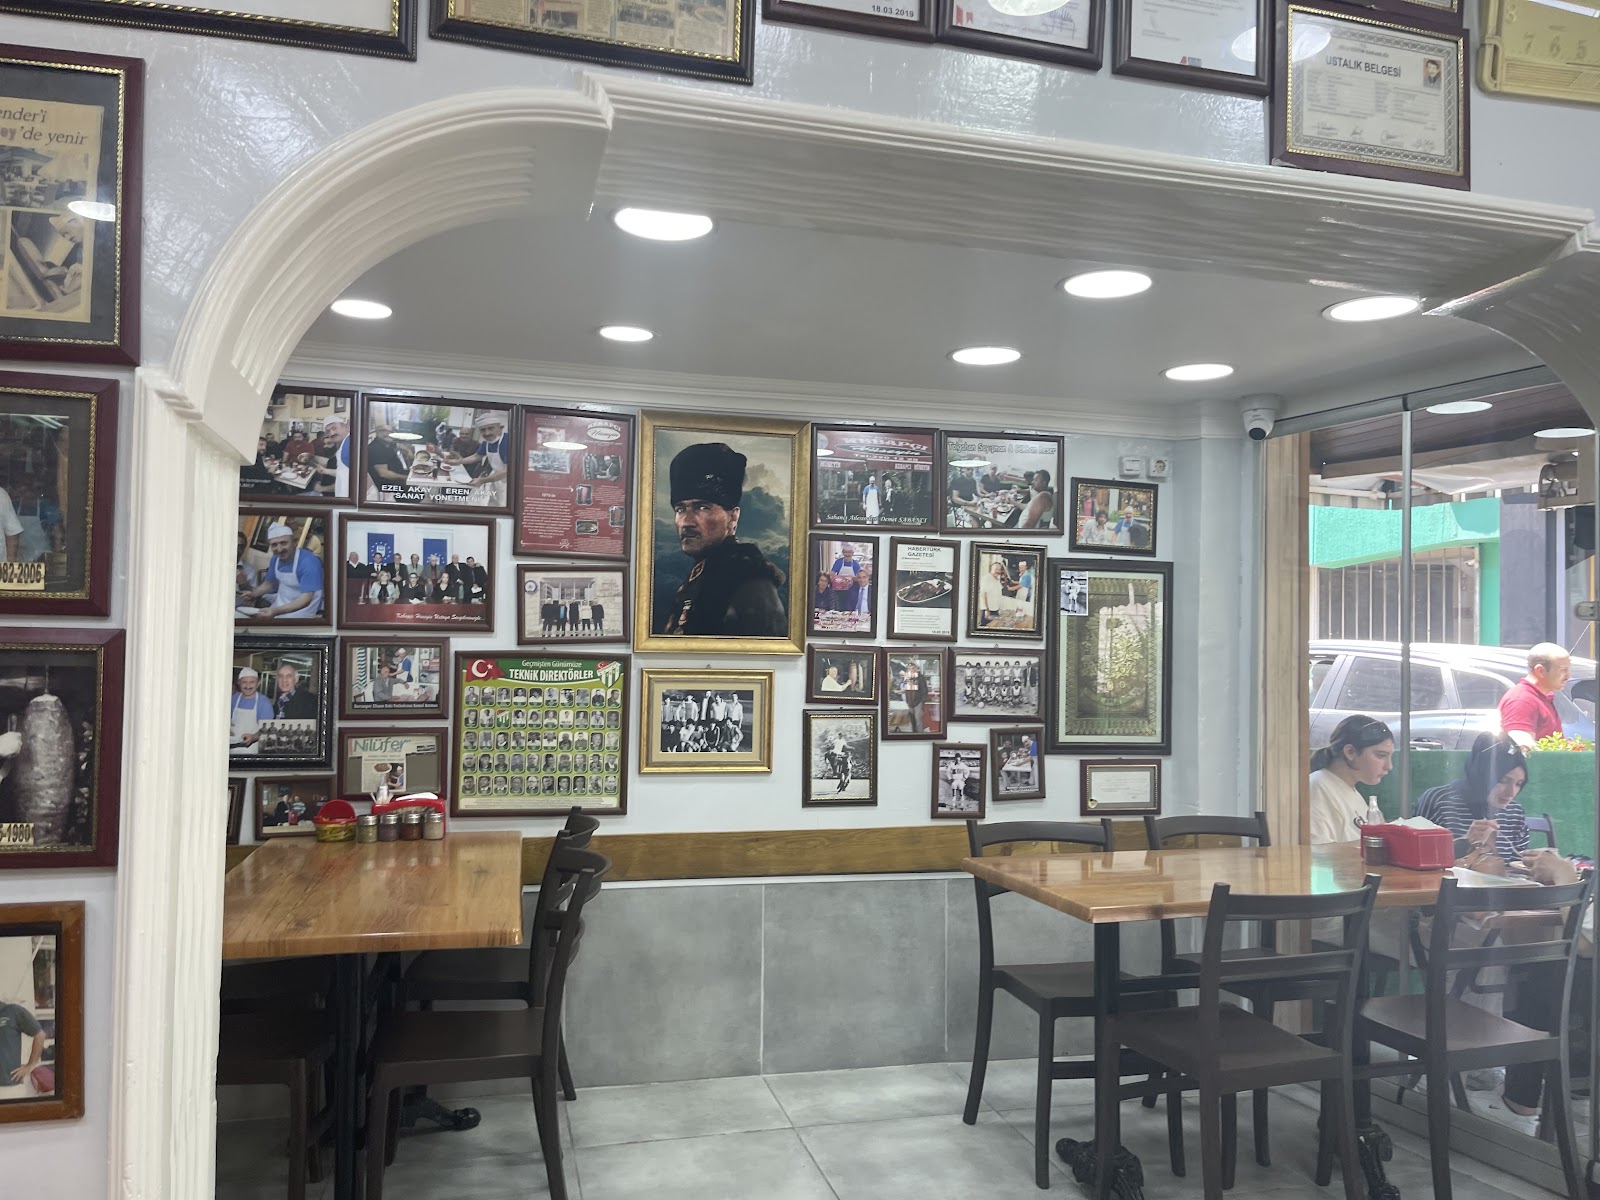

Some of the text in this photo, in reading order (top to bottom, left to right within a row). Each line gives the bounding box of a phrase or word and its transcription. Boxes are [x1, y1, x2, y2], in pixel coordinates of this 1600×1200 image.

[871, 4, 914, 18] 18.03.2019
[1326, 55, 1362, 71] USTALIK
[45, 131, 88, 146] yenir
[381, 484, 404, 492] EZEL
[395, 492, 425, 500] SANAT
[521, 659, 582, 668] Geçmişten Günümüze
[353, 737, 407, 753] Nilüfer
